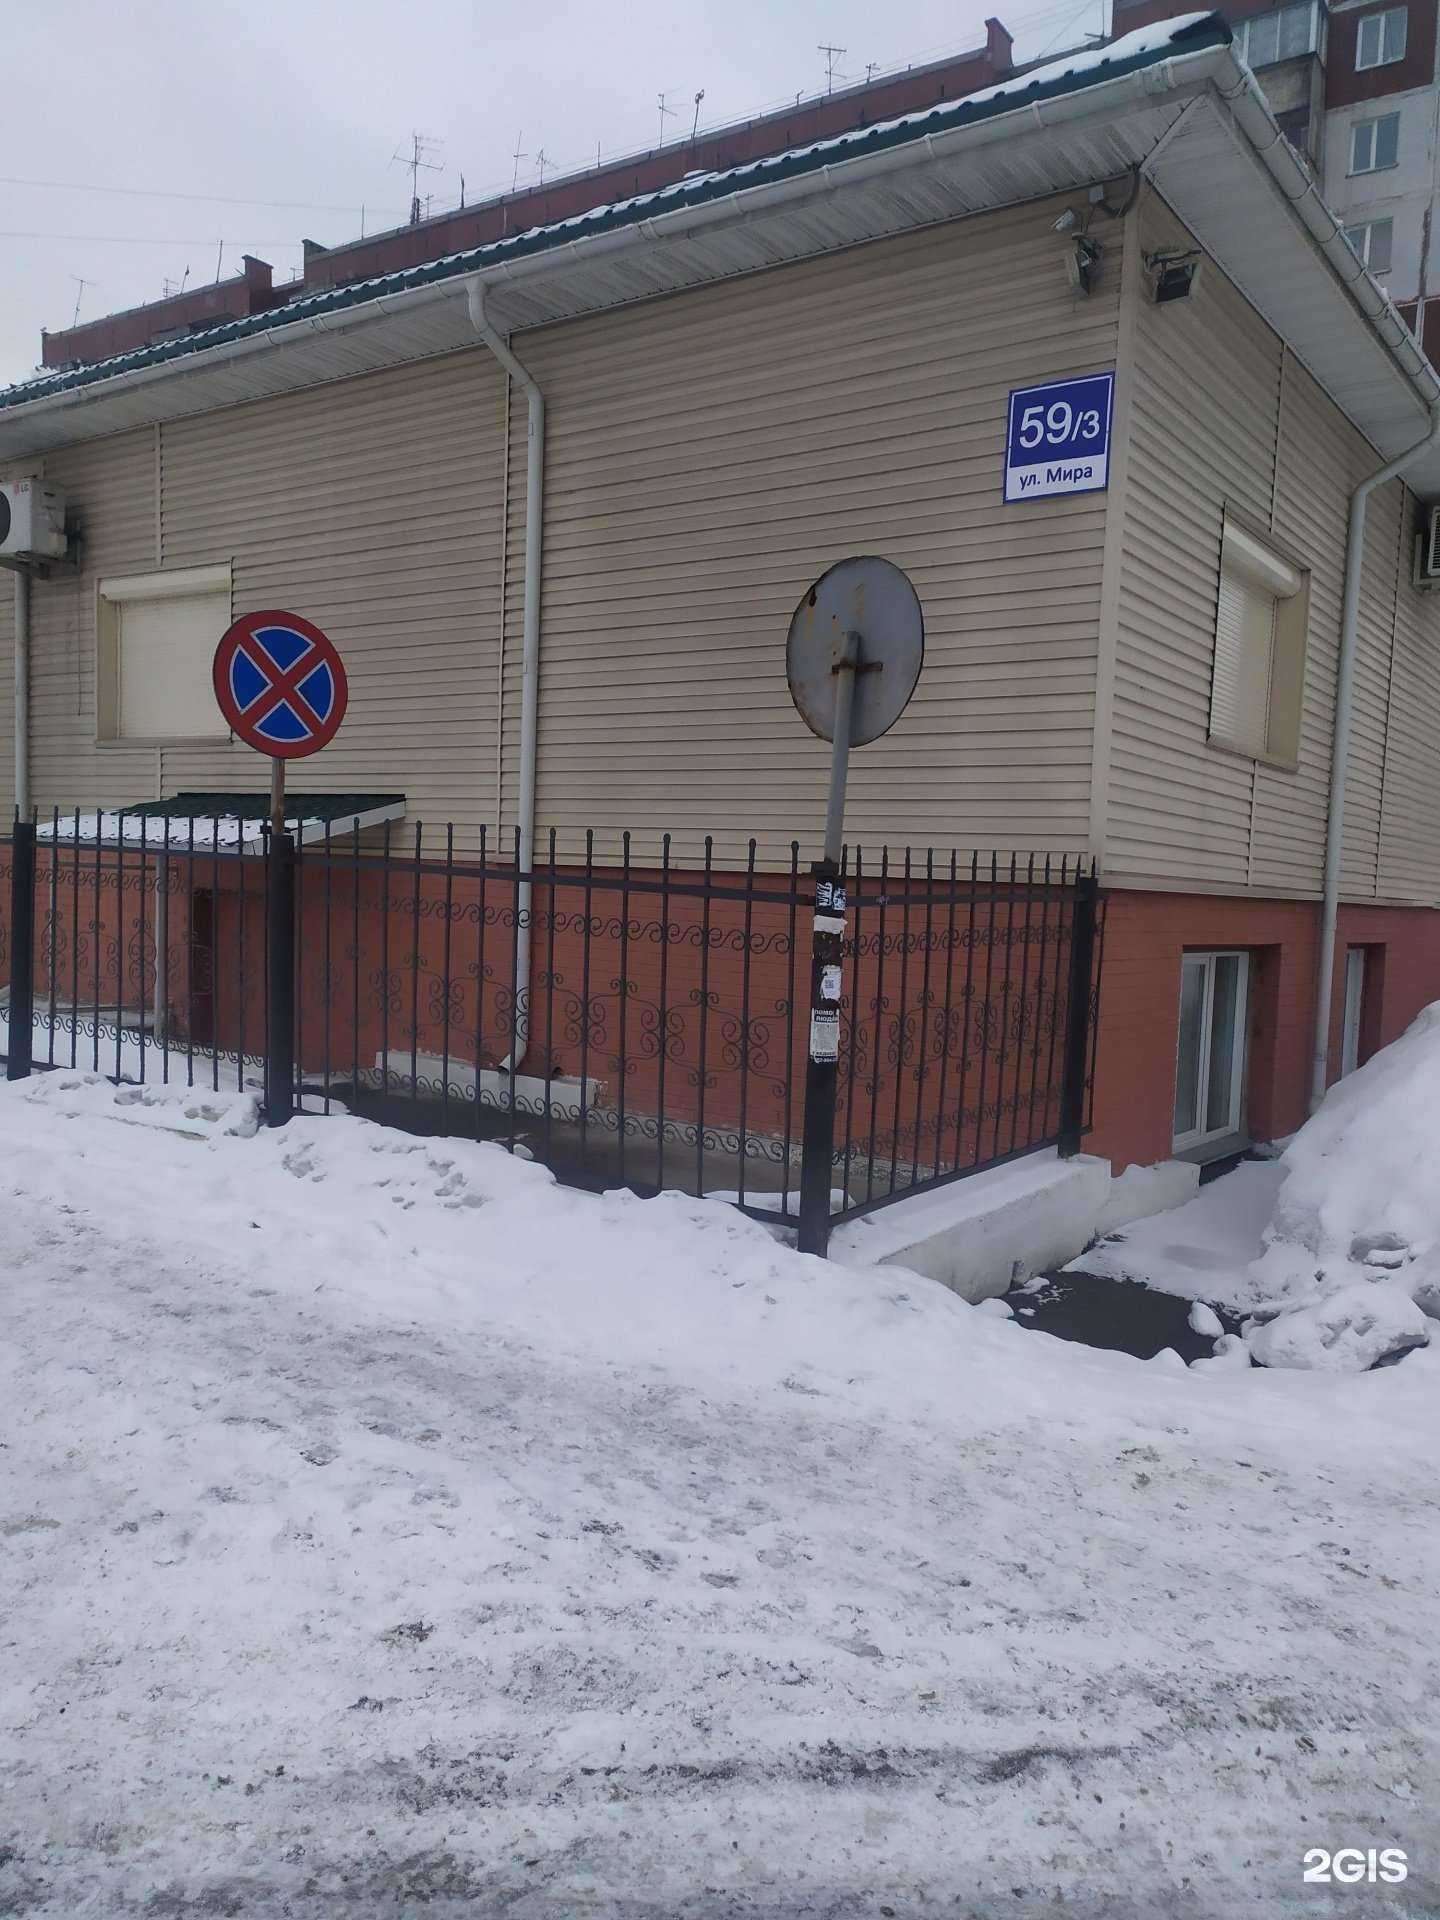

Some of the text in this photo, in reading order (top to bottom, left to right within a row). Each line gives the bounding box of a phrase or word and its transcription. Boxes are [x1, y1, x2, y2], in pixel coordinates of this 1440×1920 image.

[1019, 401, 1100, 449] 59/3
[1019, 466, 1093, 490] ул. Мира
